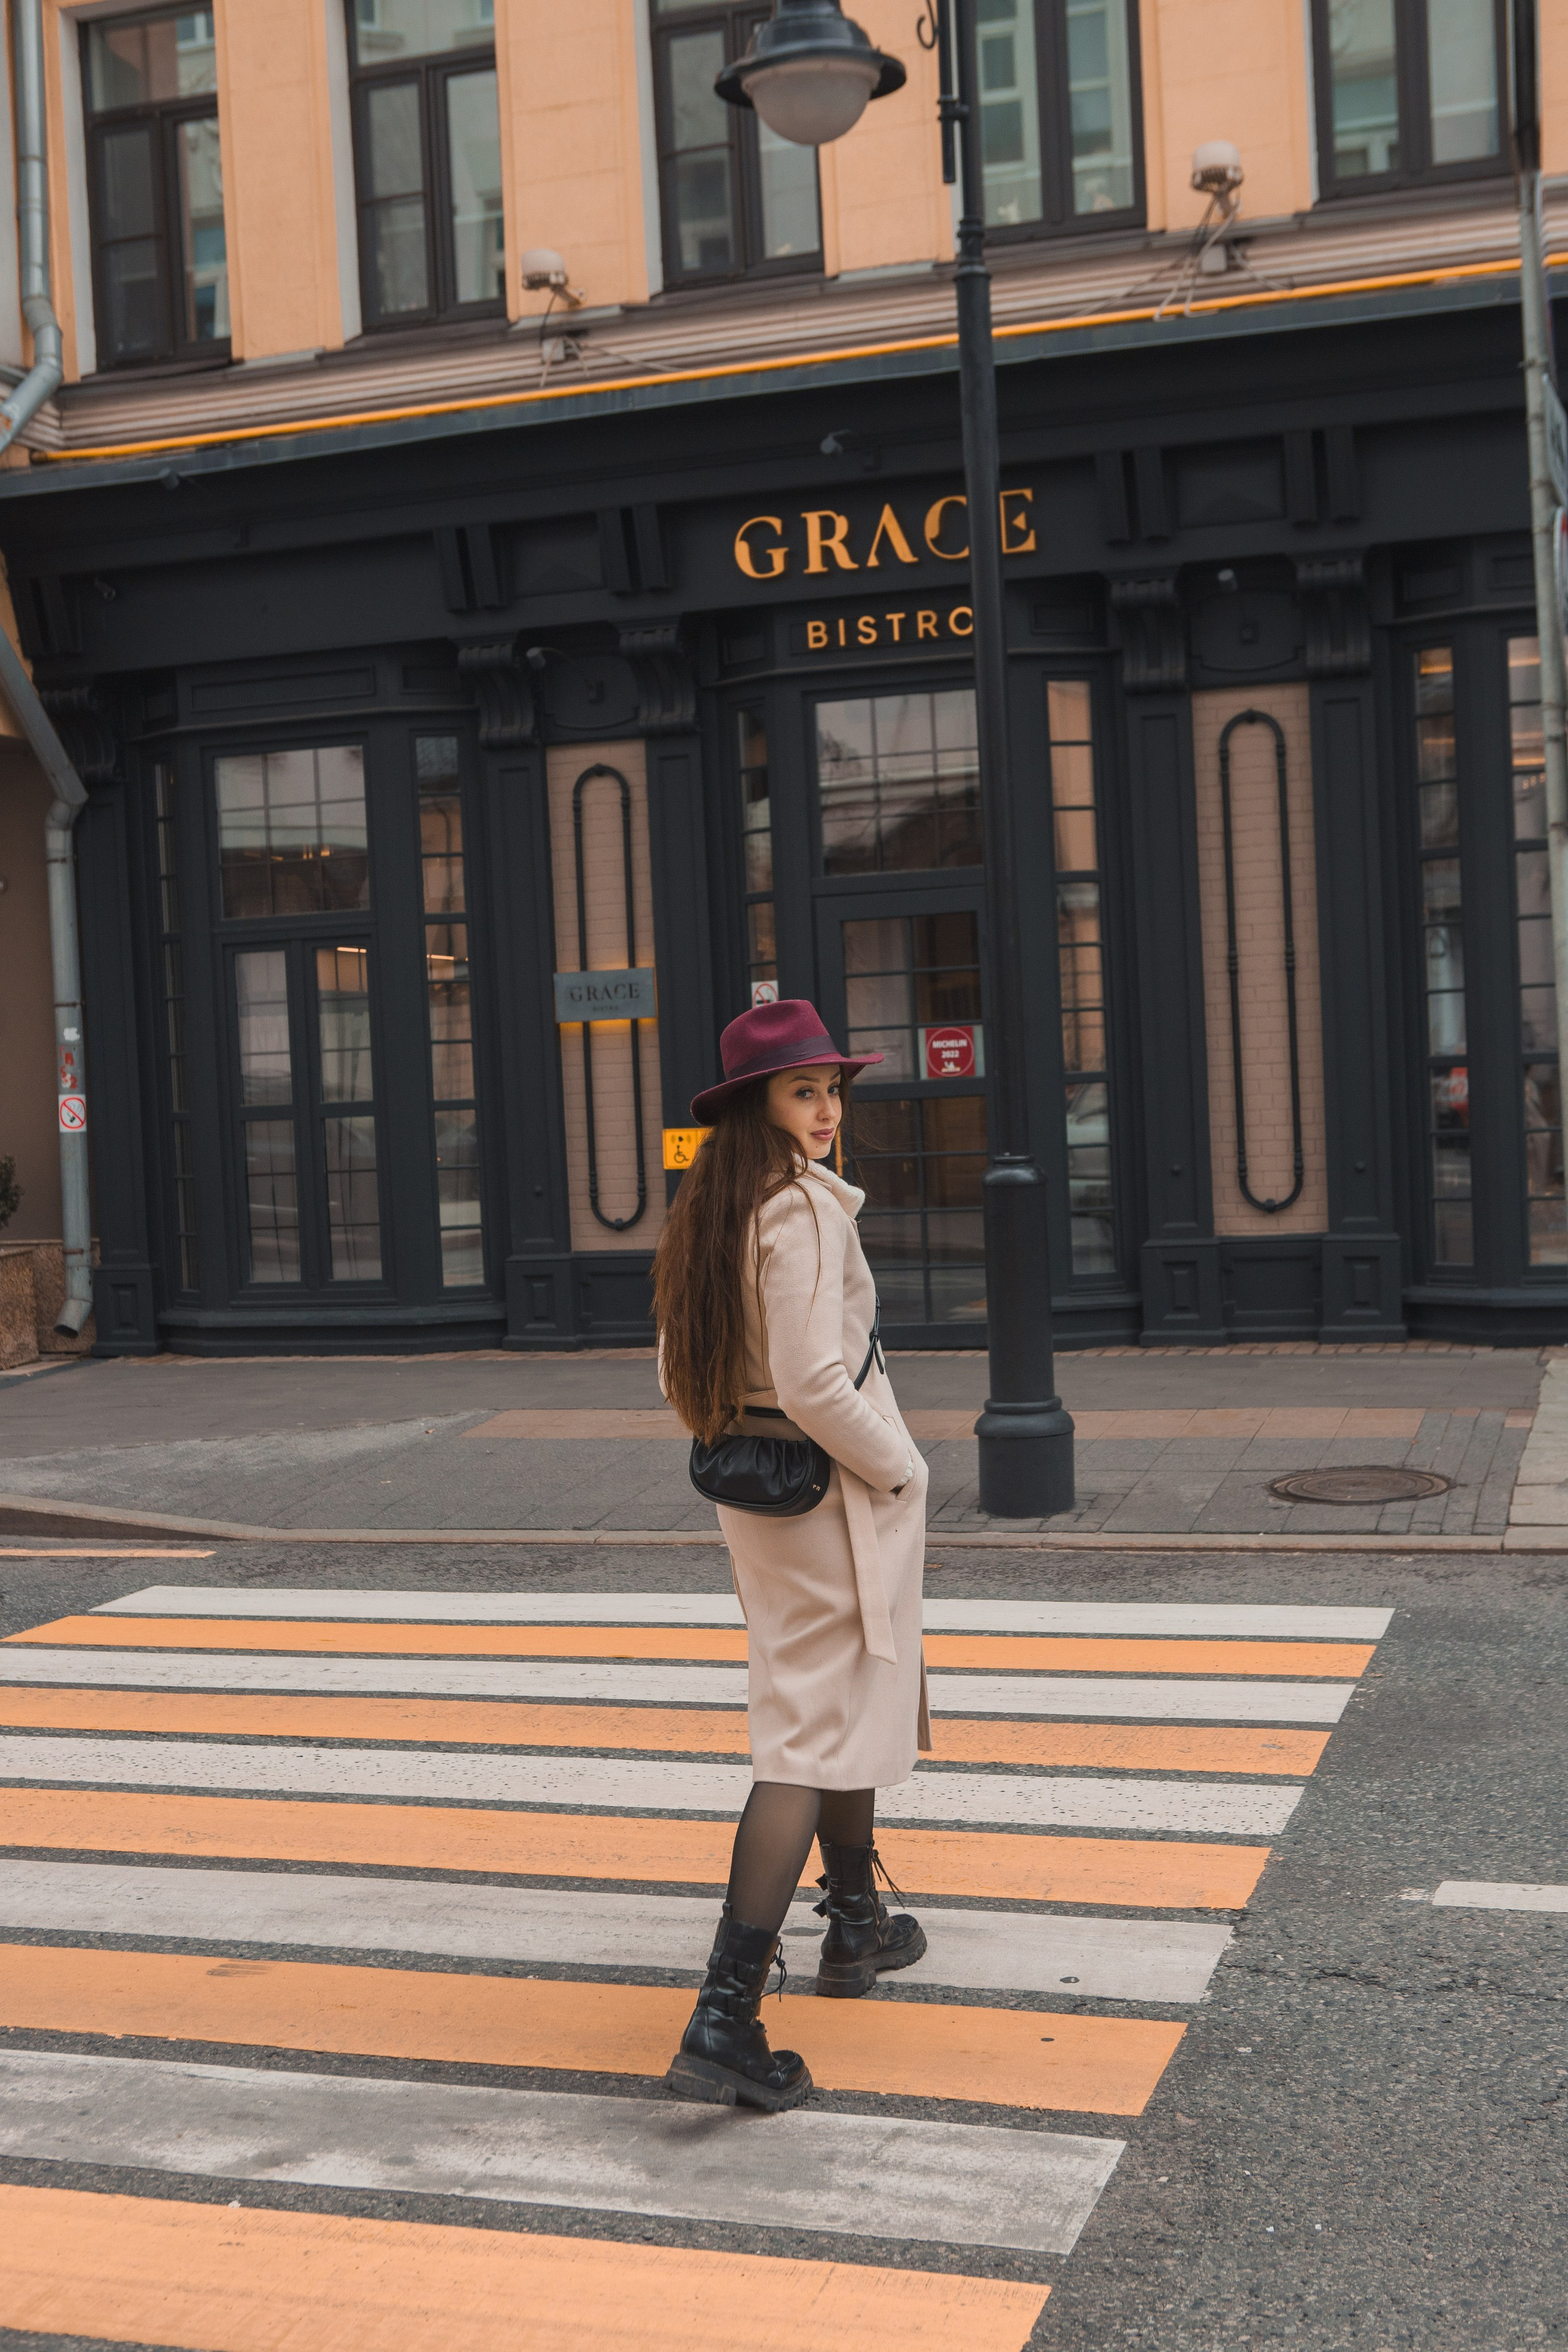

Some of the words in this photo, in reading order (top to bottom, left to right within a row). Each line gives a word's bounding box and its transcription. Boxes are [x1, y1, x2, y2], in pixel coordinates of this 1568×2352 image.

[735, 489, 1036, 578] GRACE
[570, 983, 640, 1002] GRACE
[932, 1039, 967, 1049] MICHELIN
